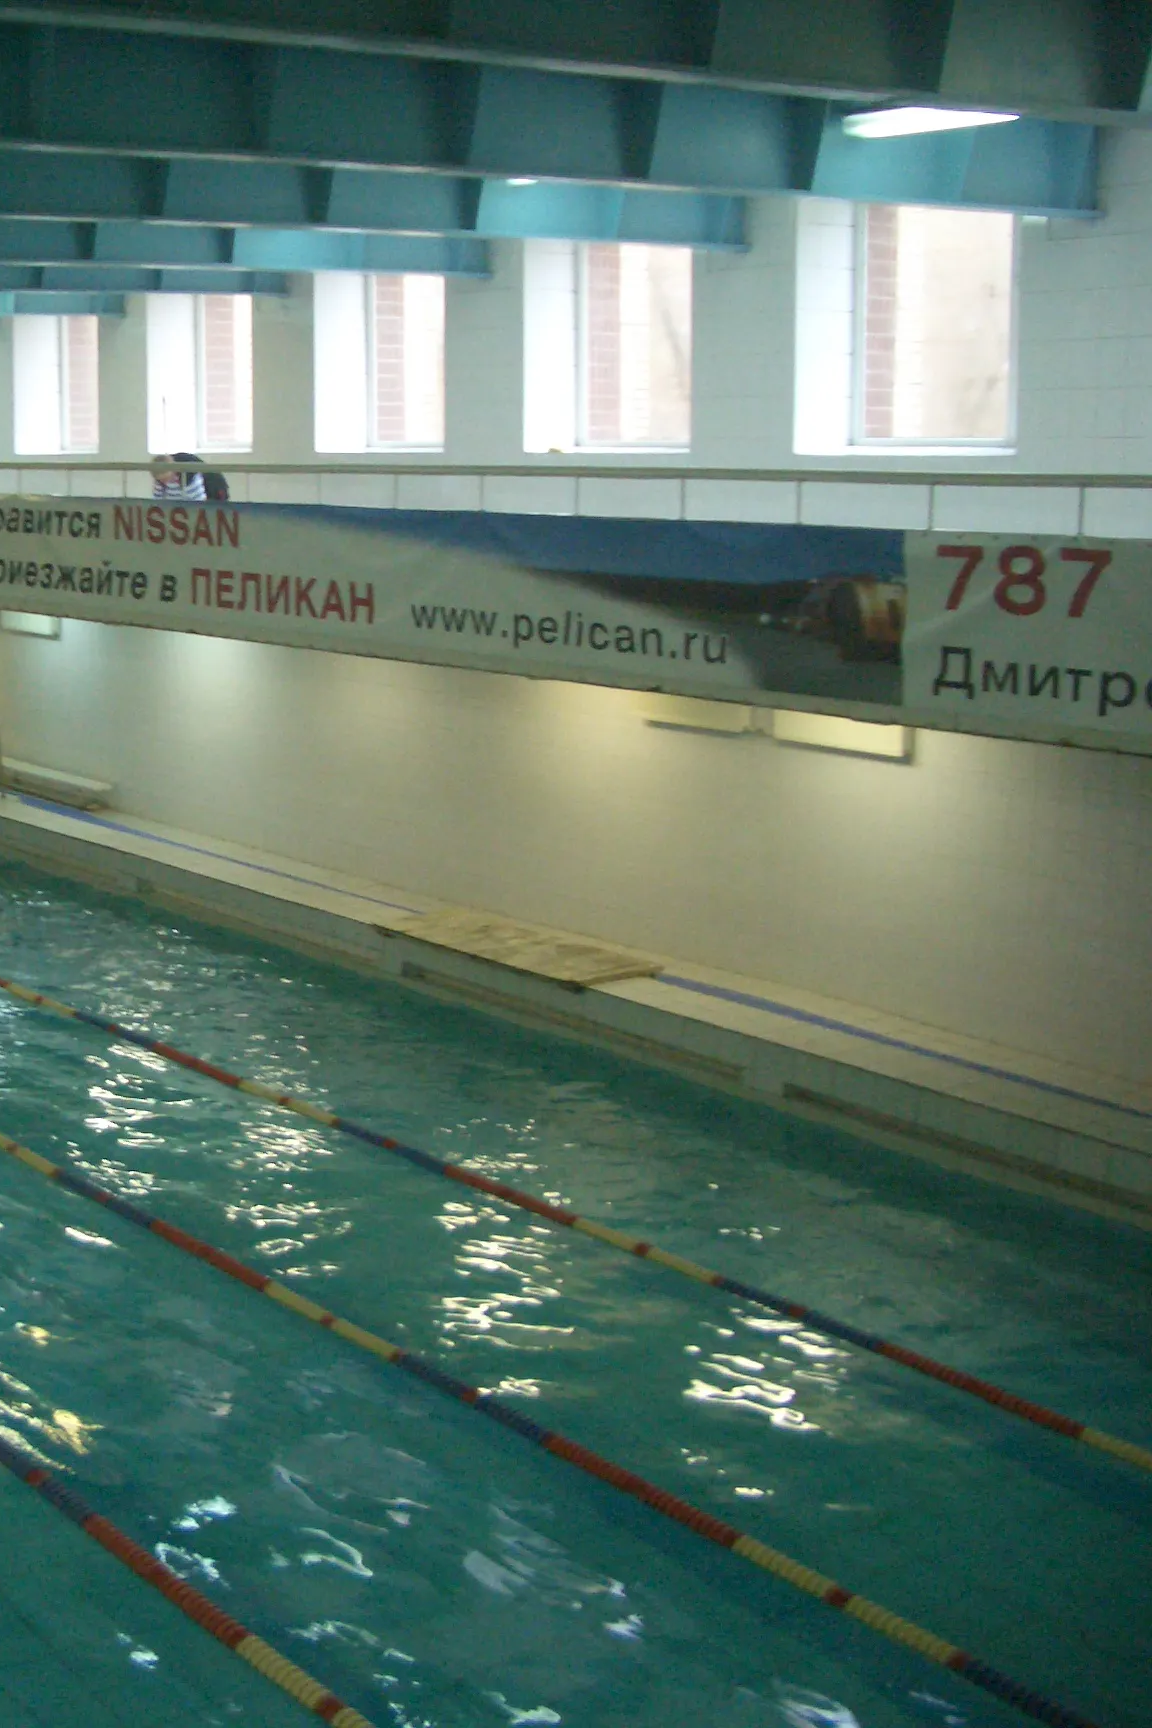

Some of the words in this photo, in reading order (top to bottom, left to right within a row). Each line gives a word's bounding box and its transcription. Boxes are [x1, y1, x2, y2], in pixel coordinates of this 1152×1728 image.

[113, 504, 240, 548] NISSAN
[159, 574, 178, 602] в
[190, 568, 375, 624] ПЕЛИКАН
[936, 545, 1112, 618] 787
[410, 604, 727, 664] www.pelican.ru
[933, 645, 1152, 716] Дмитр
